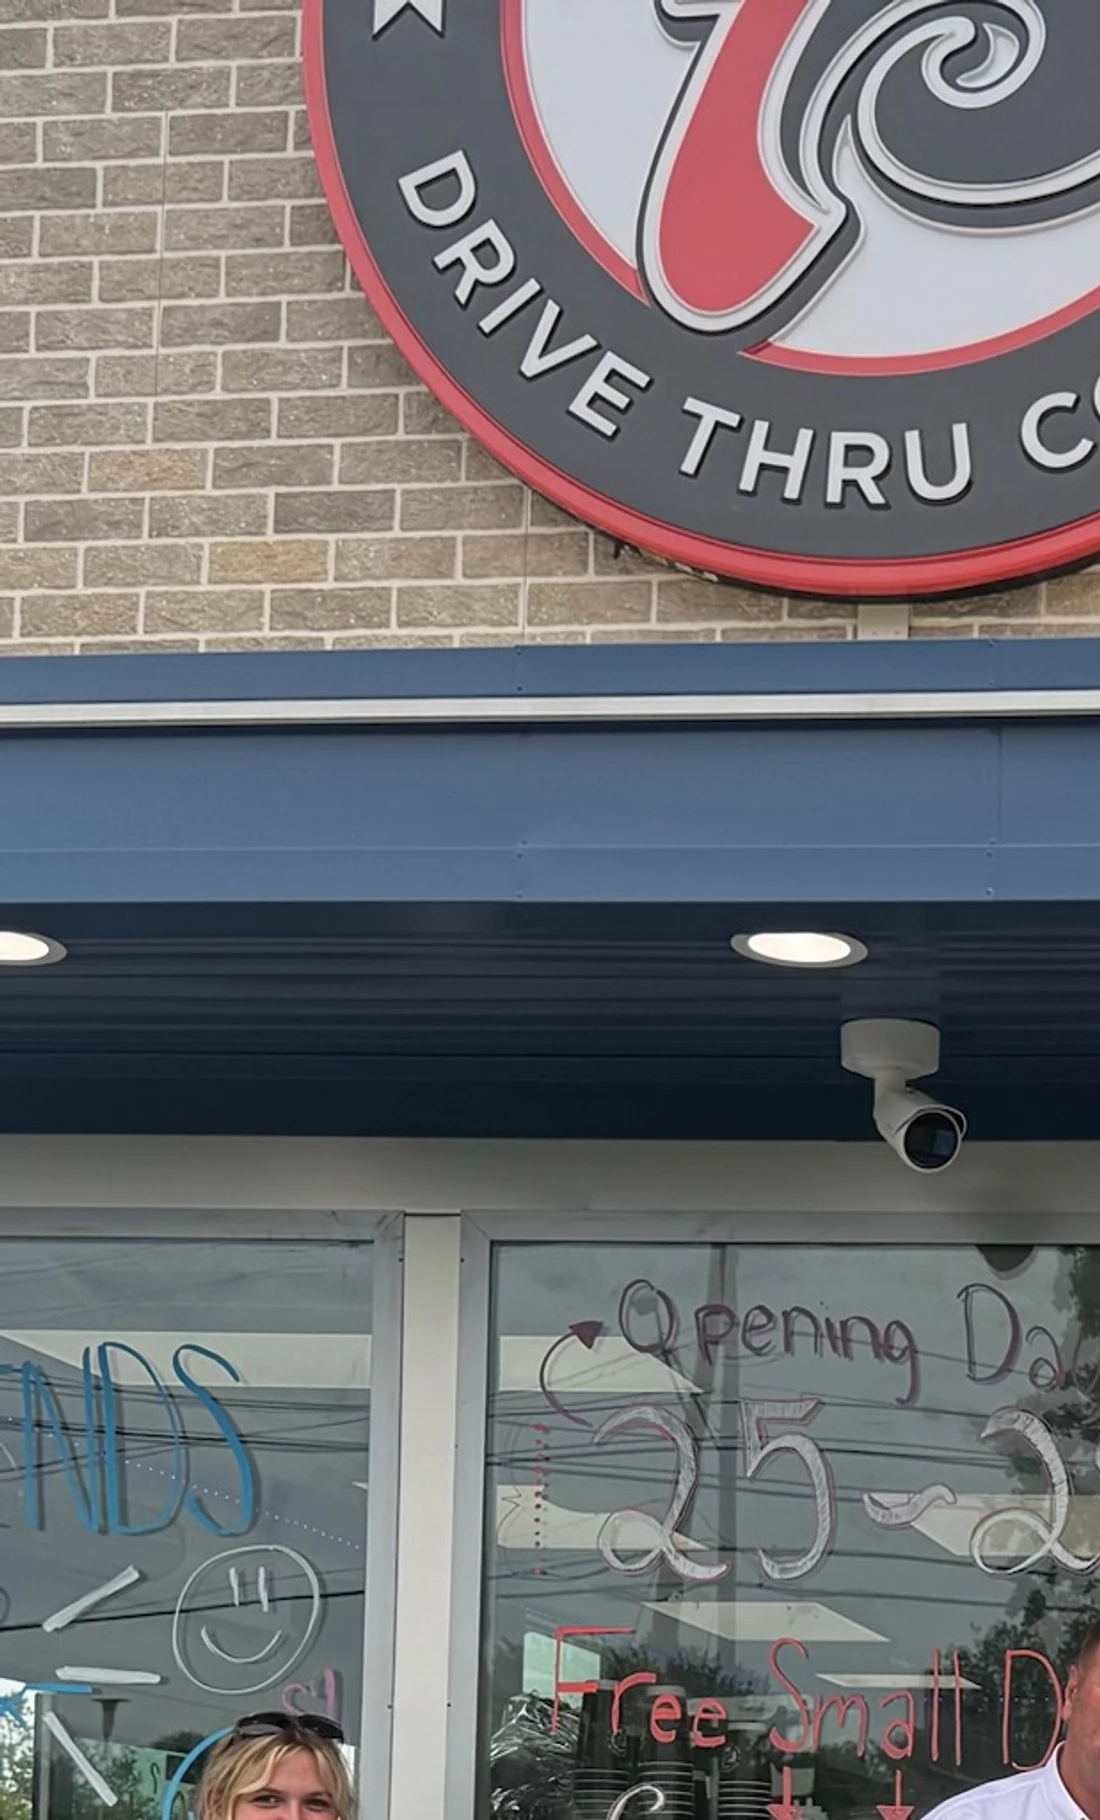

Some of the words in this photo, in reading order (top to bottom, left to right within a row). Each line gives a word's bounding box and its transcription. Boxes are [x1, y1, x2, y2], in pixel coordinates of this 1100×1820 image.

[397, 150, 653, 438] DRIVE
[677, 395, 972, 505] THRU
[618, 1279, 919, 1404] Opening
[0, 1342, 256, 1538] NDS
[550, 1626, 728, 1749] Free
[768, 1637, 963, 1767] Small
